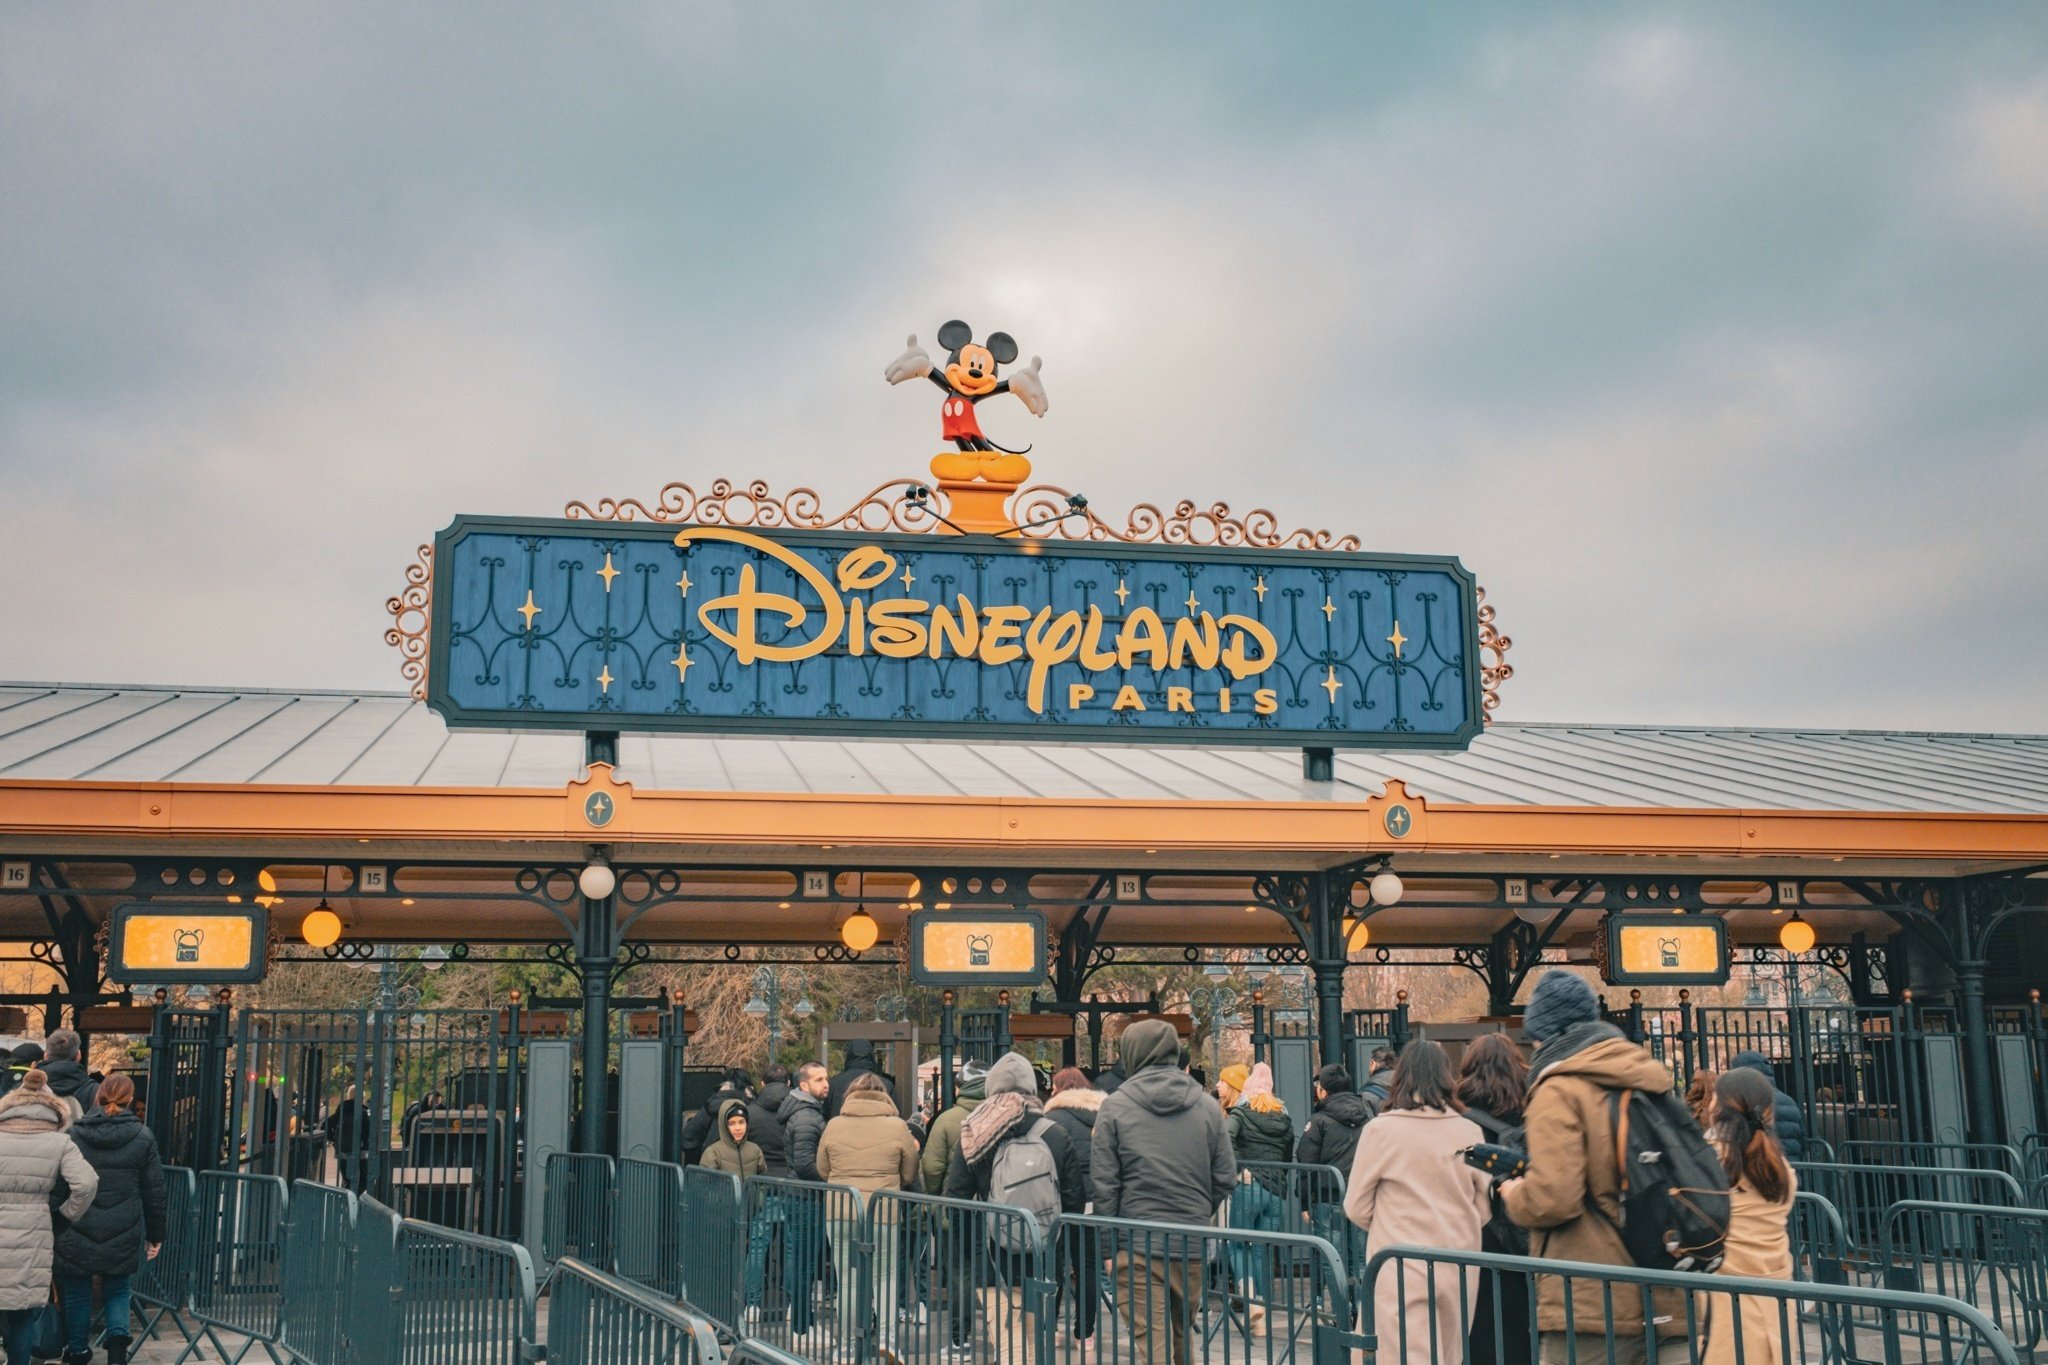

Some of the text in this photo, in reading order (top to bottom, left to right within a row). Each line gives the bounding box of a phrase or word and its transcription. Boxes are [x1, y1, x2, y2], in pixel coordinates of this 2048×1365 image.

[1070, 685, 1278, 714] PARIS
[8, 868, 24, 881] 16
[366, 872, 381, 885] 15
[809, 877, 824, 890] 14
[1122, 881, 1135, 893] 13
[1510, 885, 1522, 897] 12
[1783, 887, 1793, 898] 11
